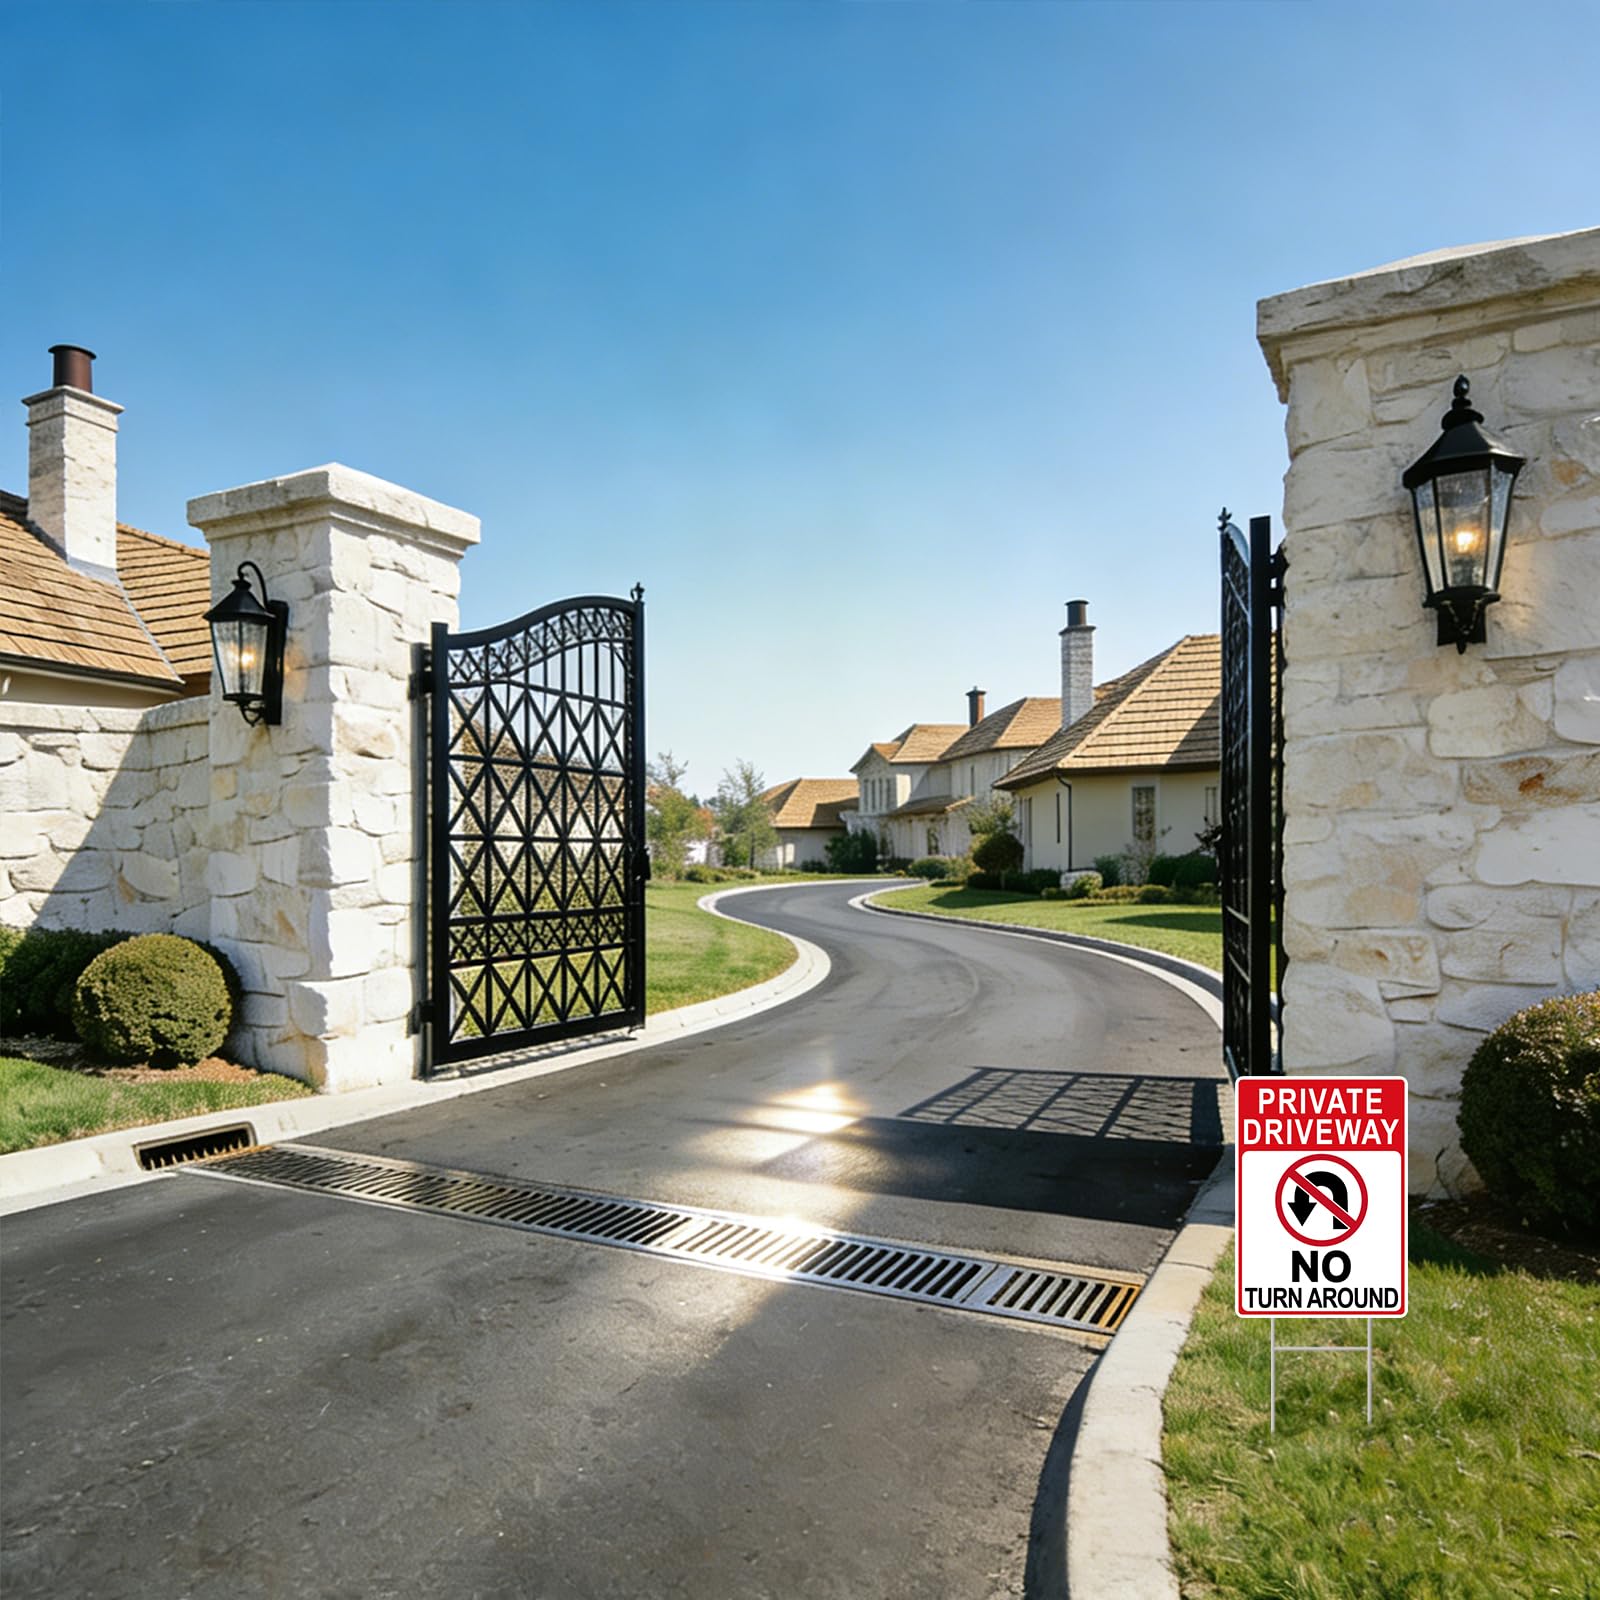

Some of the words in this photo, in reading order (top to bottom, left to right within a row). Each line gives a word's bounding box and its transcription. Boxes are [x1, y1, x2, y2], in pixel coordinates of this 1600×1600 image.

[1258, 1088, 1383, 1114] PRIVATE
[1243, 1119, 1400, 1145] DRIVEWAY
[1291, 1250, 1352, 1283] NO
[1244, 1287, 1302, 1309] TURN
[1307, 1287, 1399, 1309] AROUND
